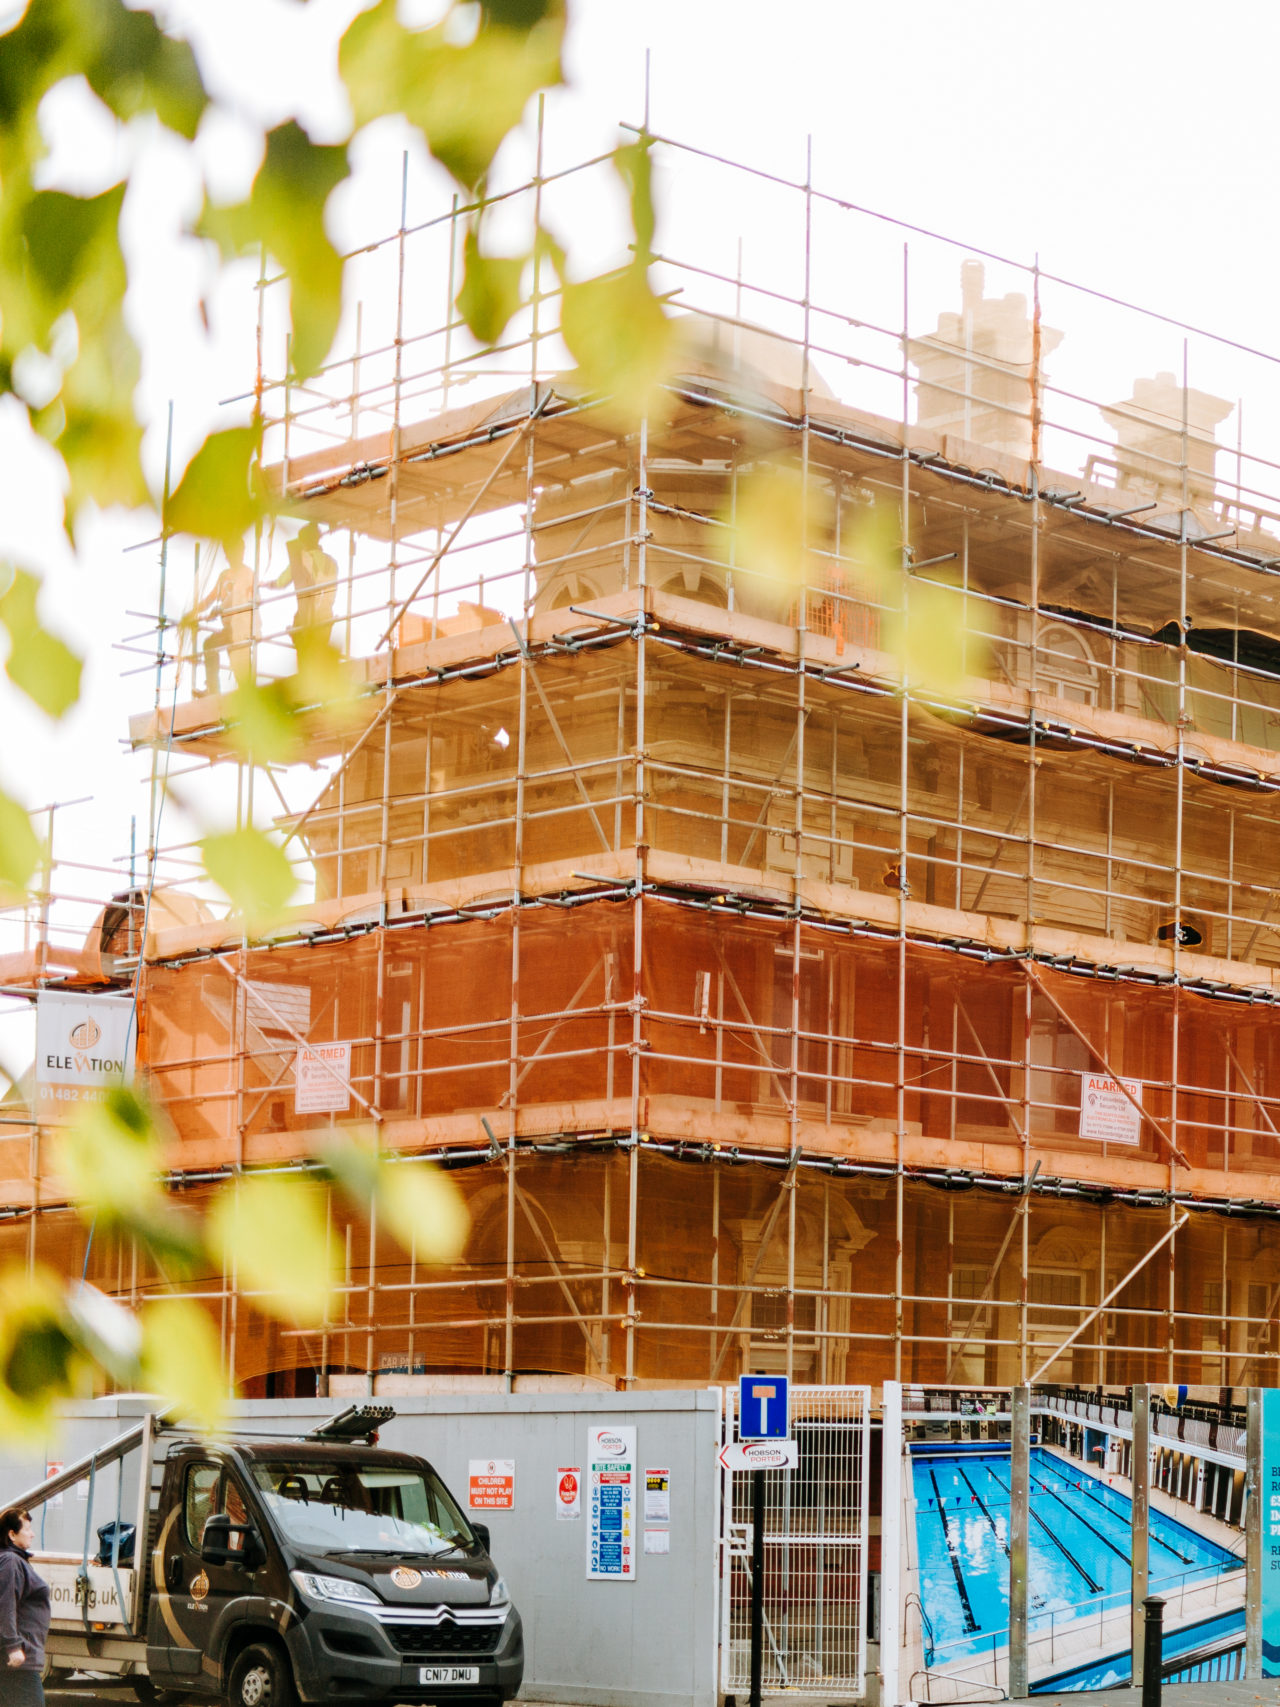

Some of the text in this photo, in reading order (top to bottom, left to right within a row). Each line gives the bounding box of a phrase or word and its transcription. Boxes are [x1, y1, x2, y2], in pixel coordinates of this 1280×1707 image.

[303, 1047, 345, 1062] ALRMED
[47, 1053, 123, 1073] ELEVATION
[40, 1087, 79, 1101] 01482
[400, 1356, 422, 1368] PAK
[426, 1669, 471, 1680] CN17 DMU
